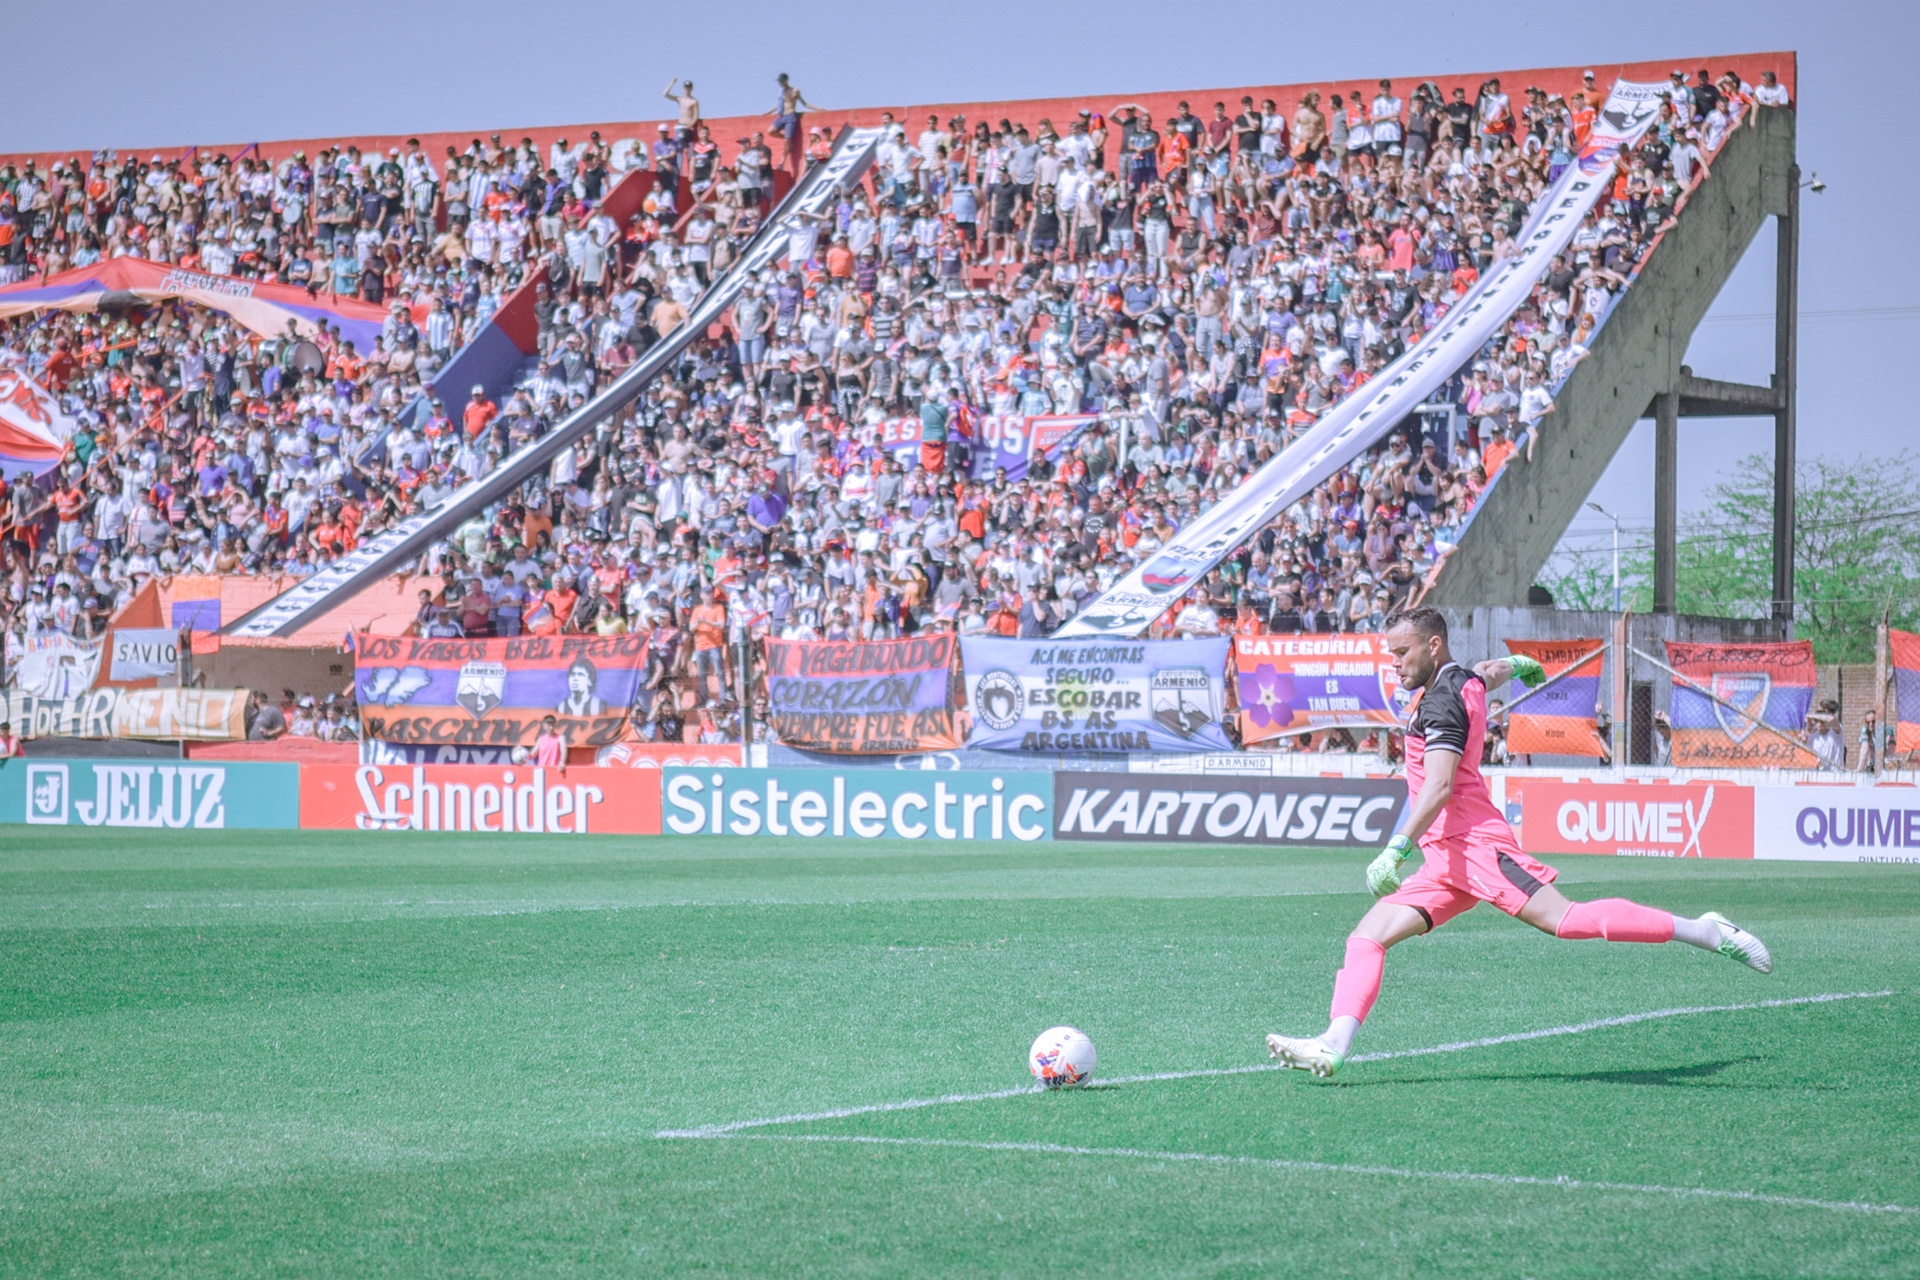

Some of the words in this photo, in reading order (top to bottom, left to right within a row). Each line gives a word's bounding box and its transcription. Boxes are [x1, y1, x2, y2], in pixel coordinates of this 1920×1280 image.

[119, 643, 177, 663] SAVIO
[358, 637, 402, 660] LOS
[407, 639, 488, 661] VAGOS
[800, 636, 950, 675] VAGABUNDO
[1056, 648, 1078, 665] ME
[1076, 646, 1146, 665] ENCONTRAS
[1331, 661, 1375, 677] JUGADOR
[1154, 677, 1208, 688] ARMENIO
[1325, 680, 1339, 694] ES
[1028, 688, 1142, 710] ESCOBAR
[1308, 697, 1329, 711] TAN
[1329, 697, 1360, 711] BUENO
[862, 709, 908, 740] FUE
[1041, 710, 1074, 731] BS
[1084, 710, 1118, 731] AS
[860, 738, 919, 751] ARMENIO
[1019, 731, 1152, 751] ARGENTINA
[75, 765, 226, 828] JELUZ
[355, 765, 604, 833] Schneider
[665, 773, 1046, 841] Sistelectric
[1058, 788, 1395, 842] KARTONSEC
[1556, 784, 1715, 859] QUIMEX
